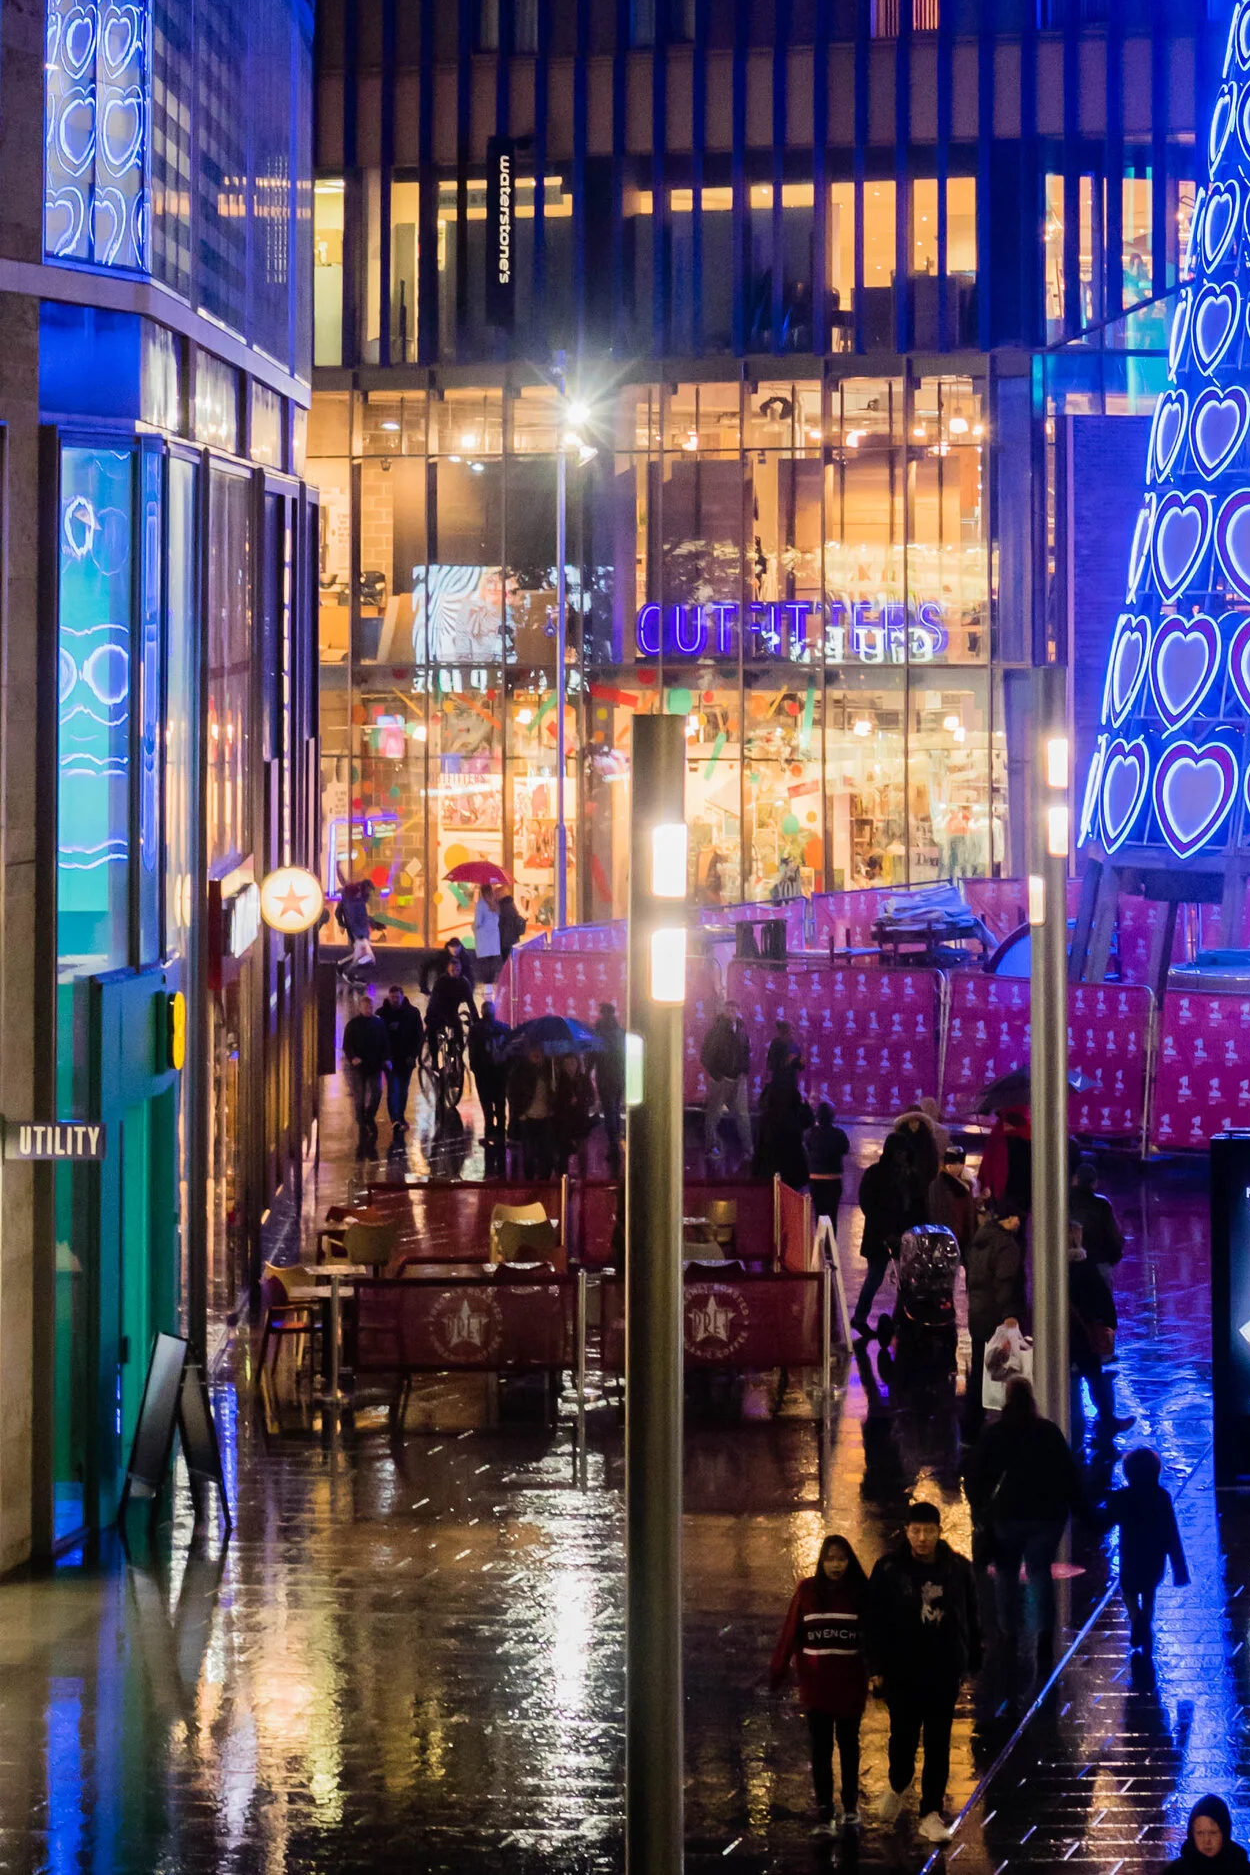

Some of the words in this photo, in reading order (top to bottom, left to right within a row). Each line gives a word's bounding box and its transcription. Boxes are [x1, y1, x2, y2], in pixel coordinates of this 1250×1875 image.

[498, 154, 512, 285] waterstone's
[20, 1126, 100, 1155] UTILITY
[445, 1312, 487, 1341] PRET
[692, 1308, 733, 1340] PRET
